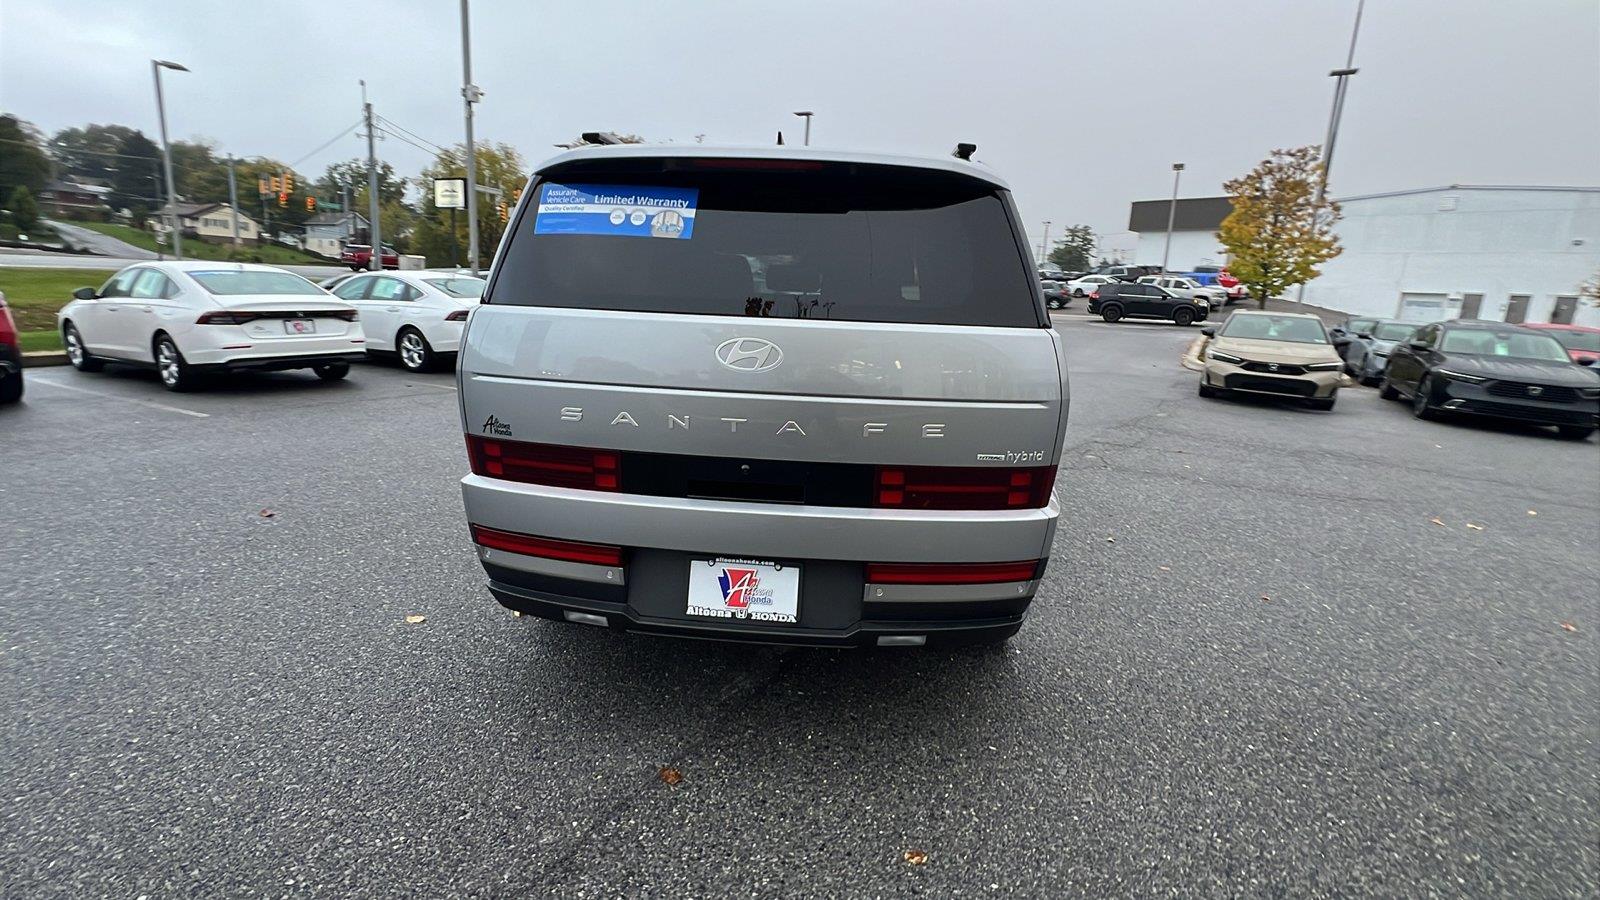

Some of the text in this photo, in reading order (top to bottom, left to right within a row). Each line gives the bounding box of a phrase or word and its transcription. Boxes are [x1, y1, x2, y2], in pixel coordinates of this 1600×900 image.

[547, 189, 578, 197] Assurant
[547, 196, 586, 204] Vehicle Care
[594, 194, 689, 209] Limited Warranty
[561, 406, 946, 438] SANTA FE
[1006, 450, 1044, 464] hybrid
[715, 557, 775, 566] altoonahonda.com
[743, 595, 772, 604] Honda
[686, 605, 798, 623] Altoona HONDA
